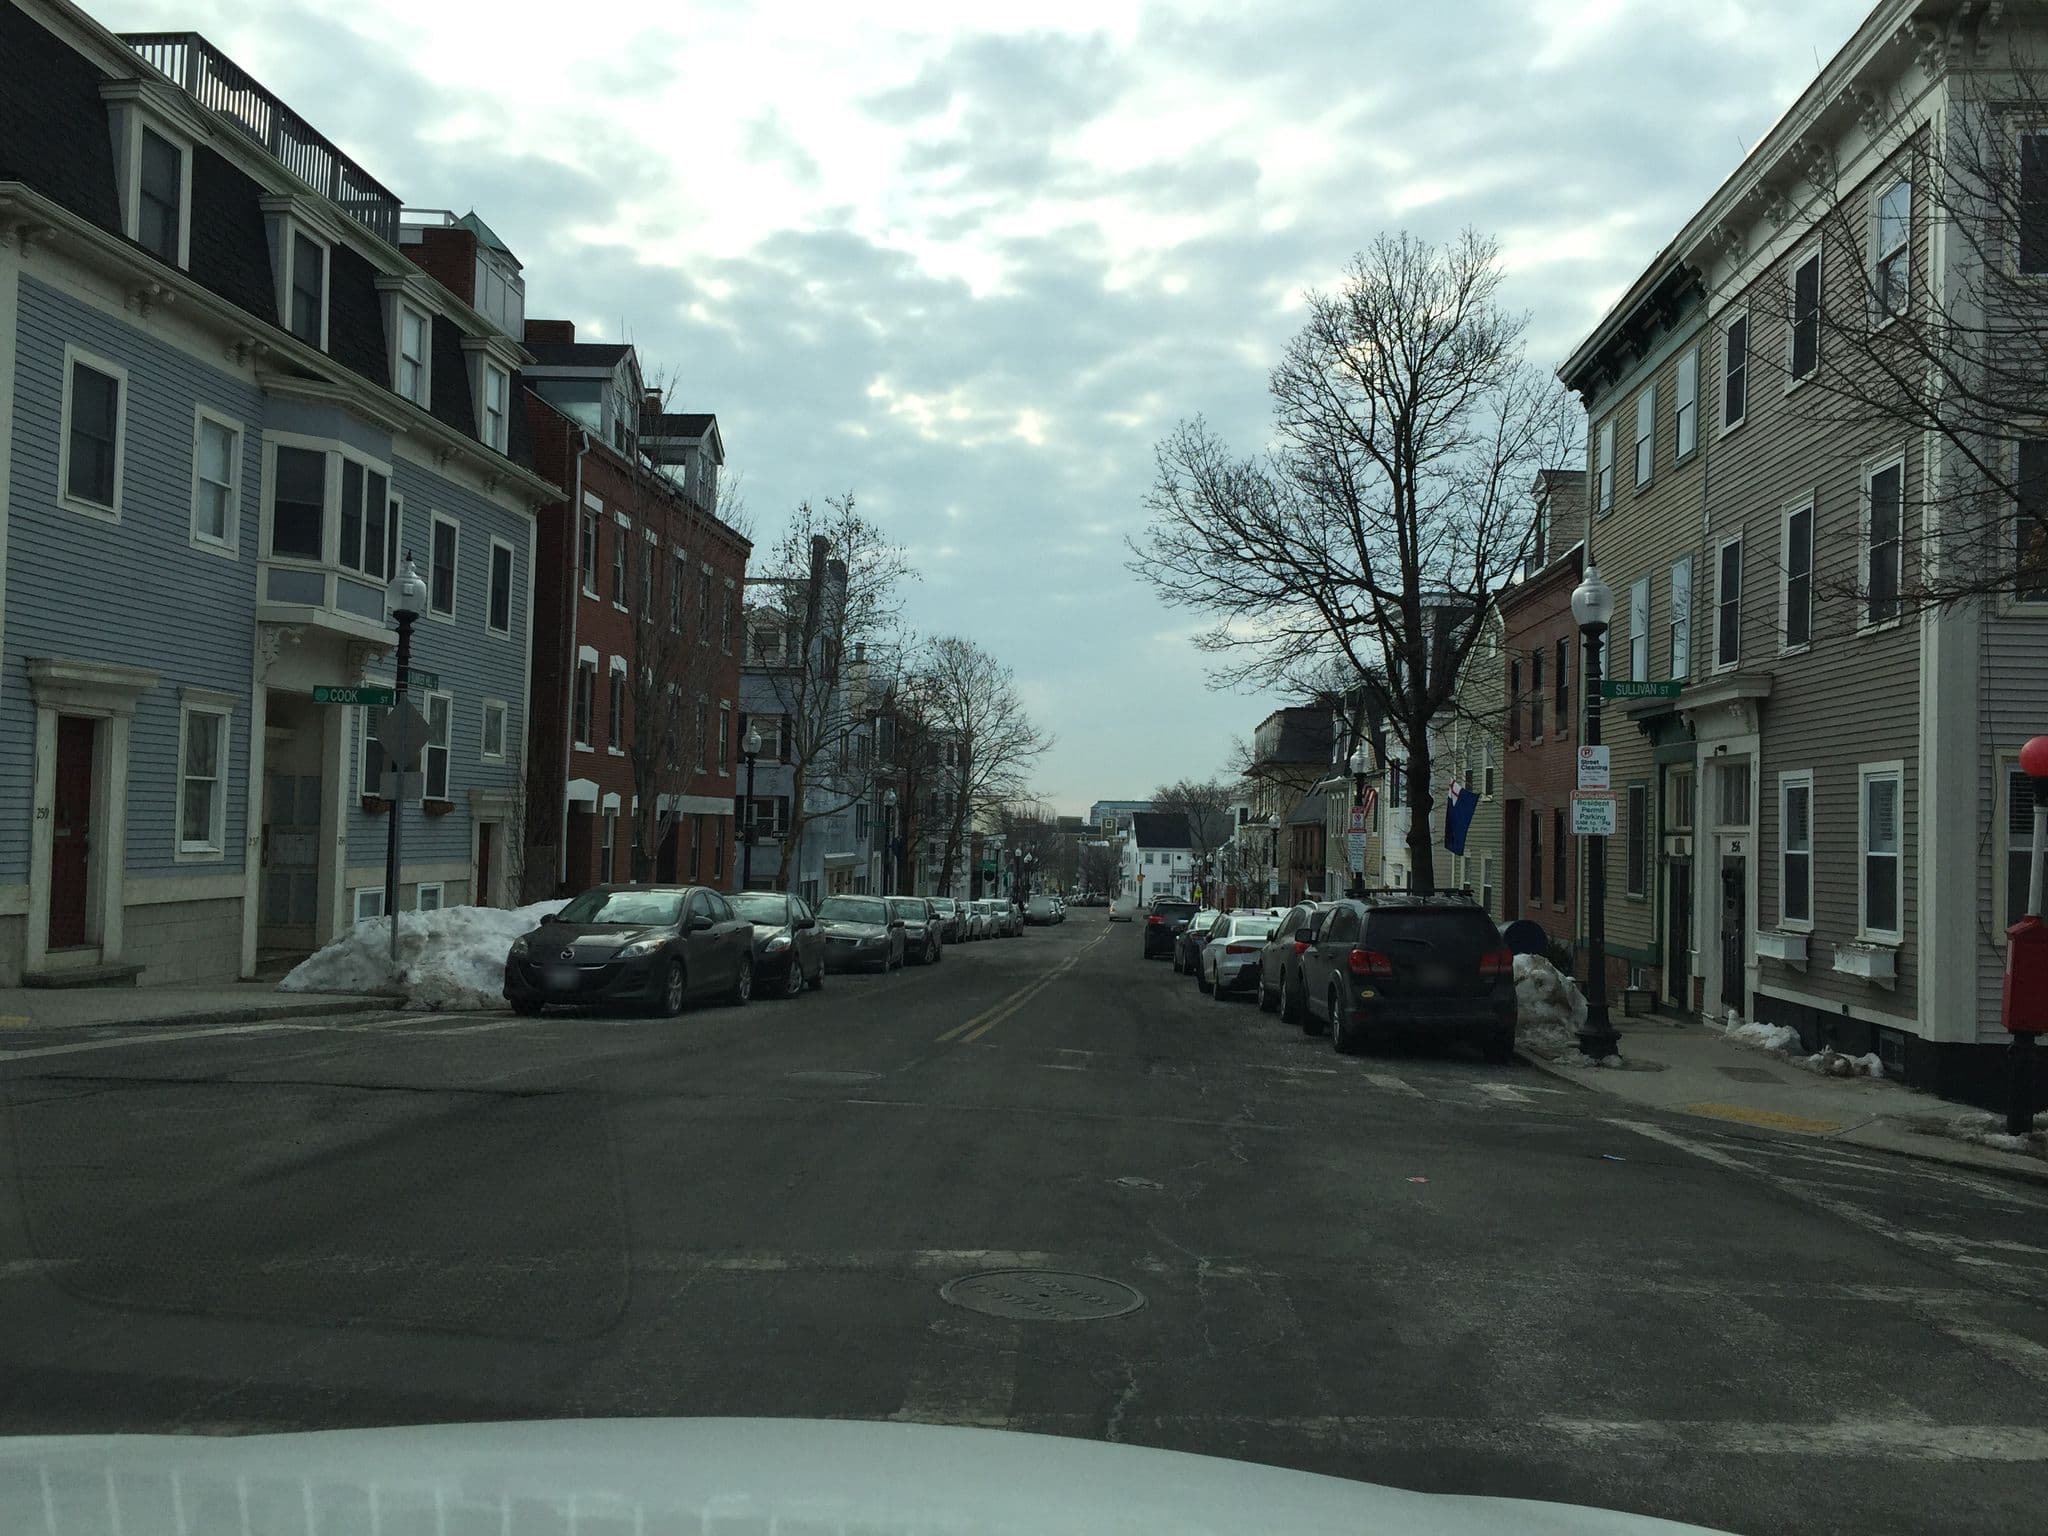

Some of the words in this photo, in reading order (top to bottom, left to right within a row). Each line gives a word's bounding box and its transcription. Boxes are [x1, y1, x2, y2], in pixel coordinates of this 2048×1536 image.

[330, 688, 358, 702] COOK
[379, 696, 389, 704] ST
[1616, 683, 1657, 696] SULLIVAN
[1660, 686, 1670, 695] ST
[1579, 813, 1606, 821] Parking
